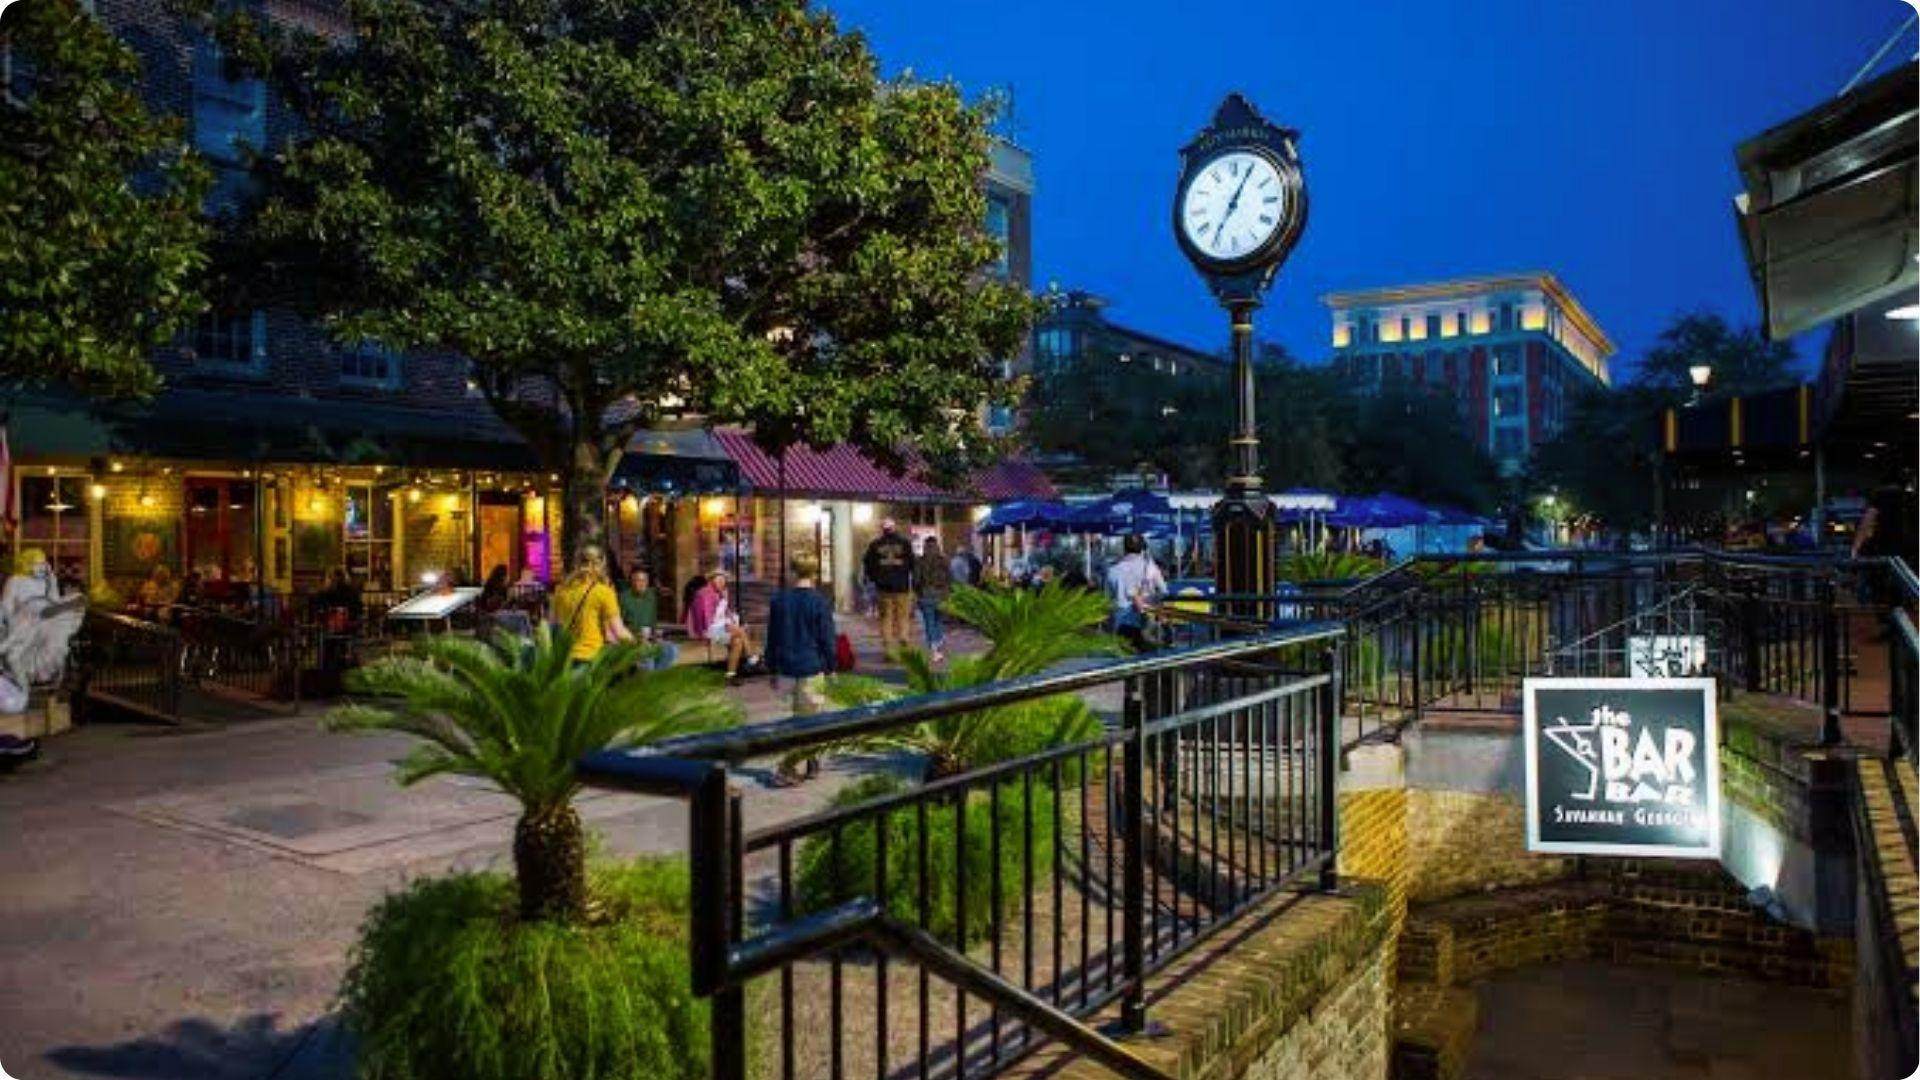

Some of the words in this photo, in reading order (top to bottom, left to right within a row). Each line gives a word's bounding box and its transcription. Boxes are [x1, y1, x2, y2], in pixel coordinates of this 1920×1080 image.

[1592, 705, 1631, 726] the
[1601, 725, 1697, 783] BAR
[1605, 781, 1694, 806] BAR
